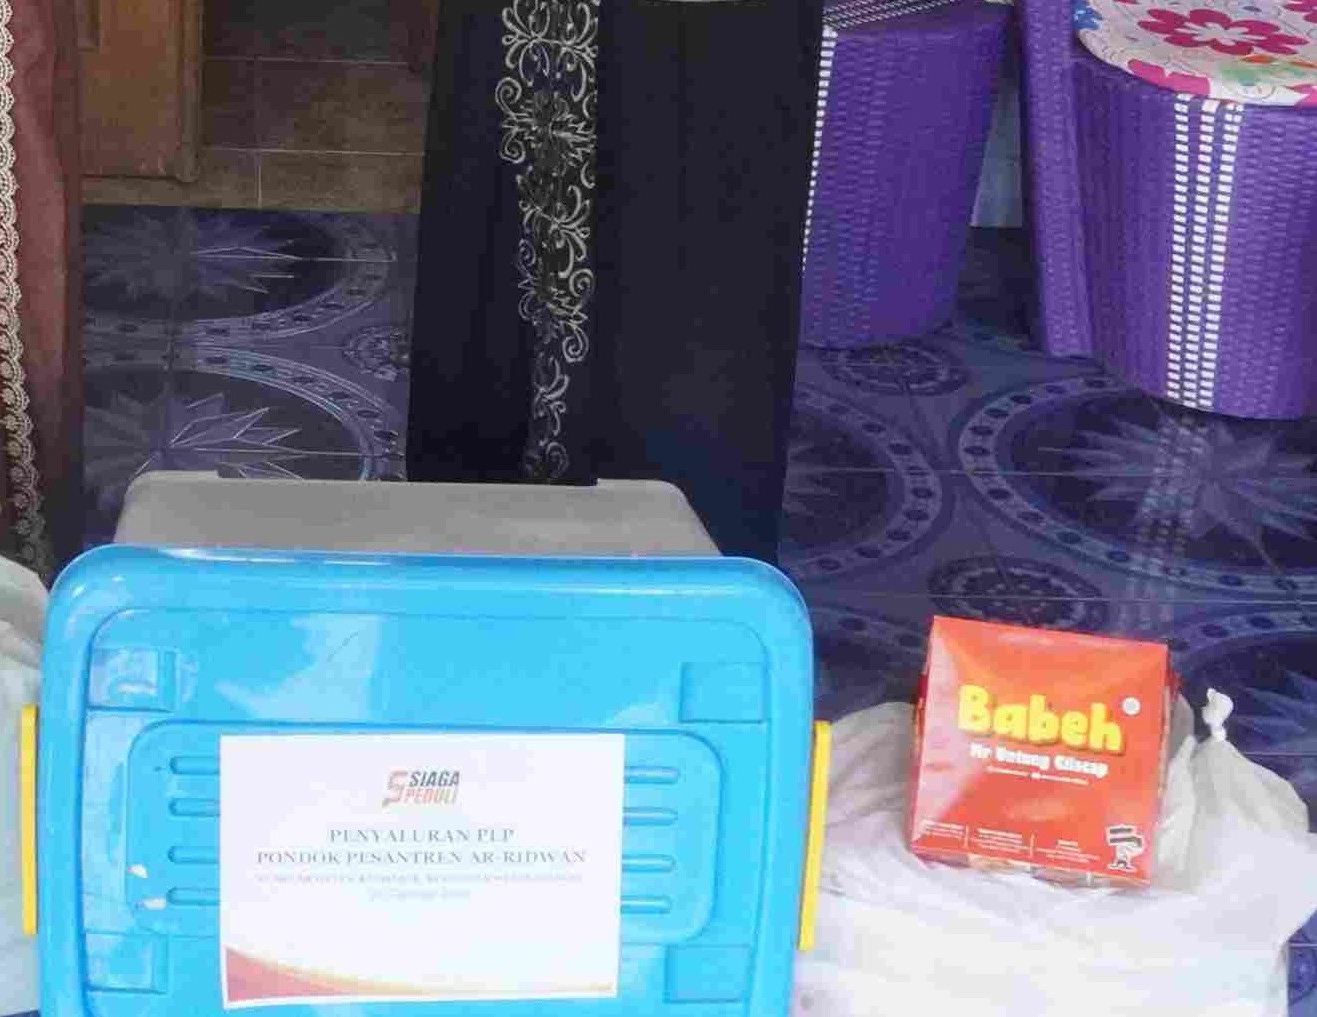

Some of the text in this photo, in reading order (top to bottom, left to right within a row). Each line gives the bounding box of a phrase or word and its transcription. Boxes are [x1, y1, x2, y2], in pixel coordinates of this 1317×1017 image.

[957, 683, 1126, 756] Babeh
[408, 769, 461, 787] SIAGA
[329, 828, 471, 844] PENYALURAN
[256, 849, 588, 865] PONDOK PESANTREN AR-RIDWAN
